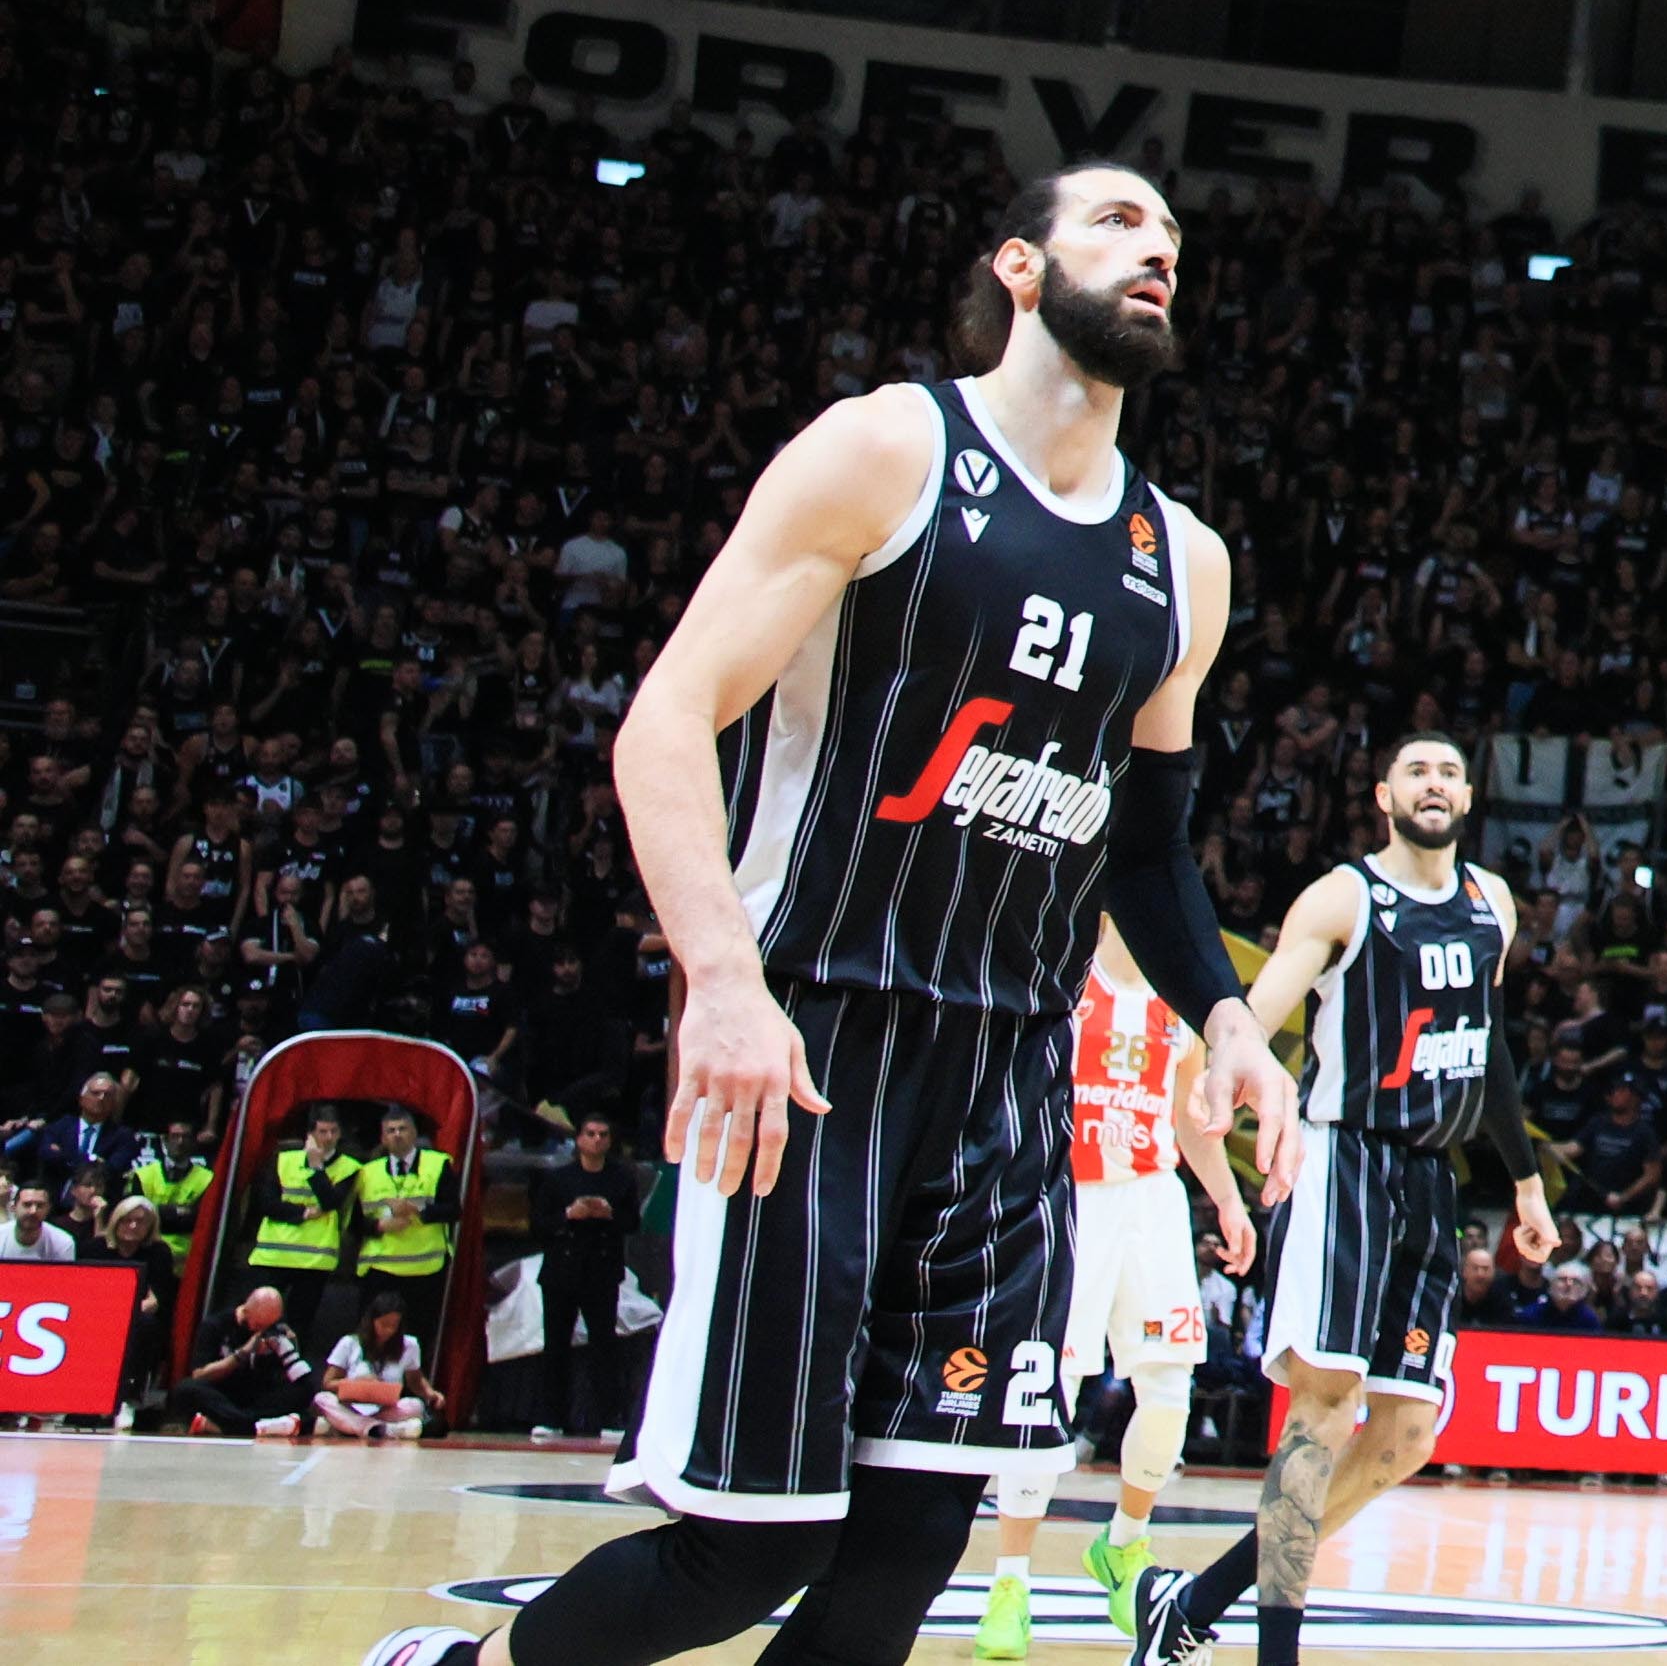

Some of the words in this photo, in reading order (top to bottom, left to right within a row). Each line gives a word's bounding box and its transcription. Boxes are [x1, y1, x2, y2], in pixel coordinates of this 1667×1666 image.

[1008, 593, 1094, 692] 21
[1419, 941, 1474, 991] 00
[1101, 1030, 1152, 1073] 26
[1082, 1117, 1151, 1149] mts
[0, 1301, 70, 1376] S
[1169, 1306, 1204, 1344] 26
[1002, 1340, 1061, 1427] 2
